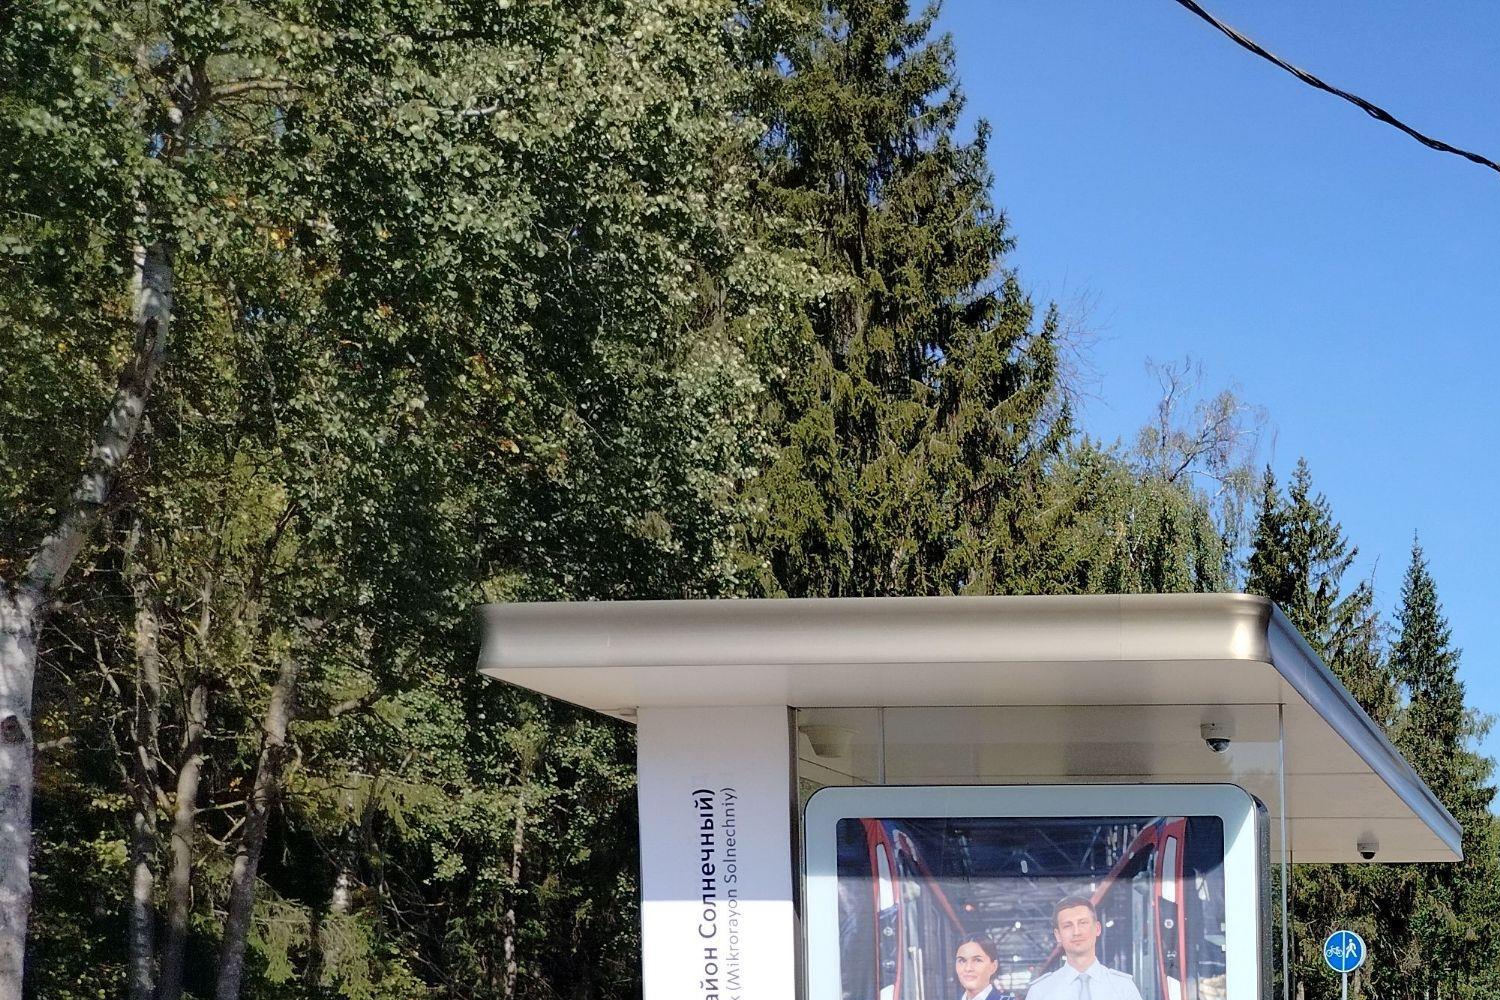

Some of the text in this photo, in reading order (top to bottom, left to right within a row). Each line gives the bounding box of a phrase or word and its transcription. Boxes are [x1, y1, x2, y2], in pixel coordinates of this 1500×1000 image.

[692, 788, 717, 938] Солнечный)
[719, 787, 737, 884] Solnechniy)
[725, 889, 742, 991] (Mikrorayon
